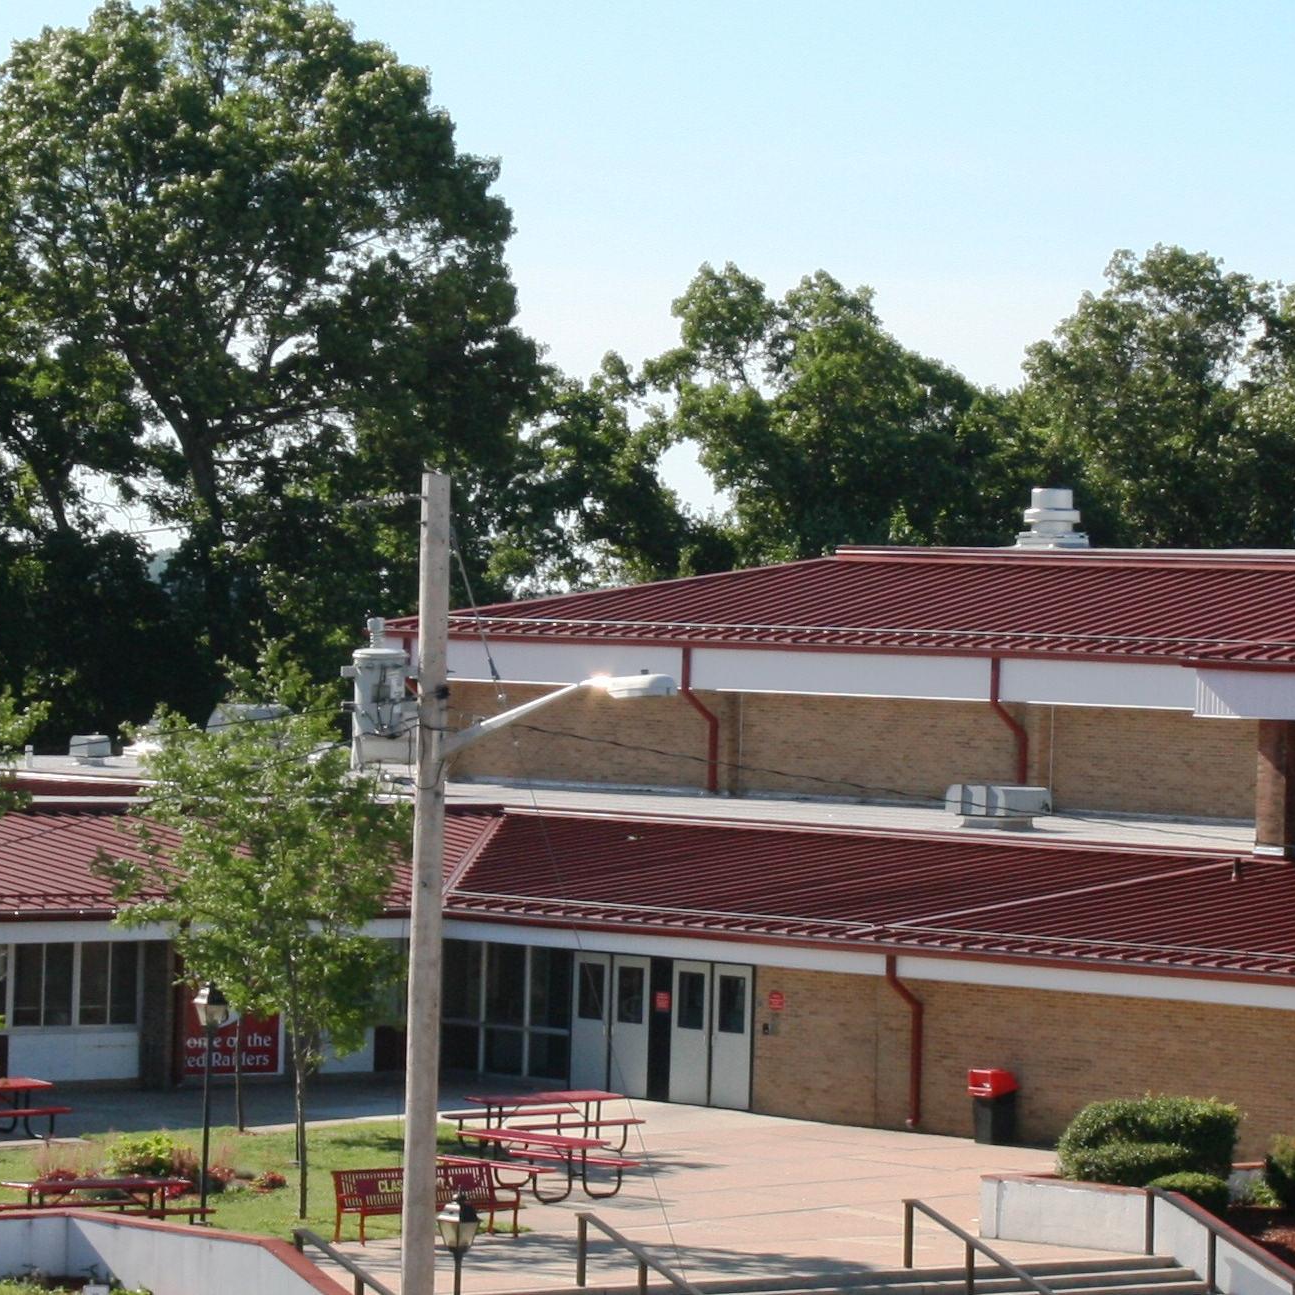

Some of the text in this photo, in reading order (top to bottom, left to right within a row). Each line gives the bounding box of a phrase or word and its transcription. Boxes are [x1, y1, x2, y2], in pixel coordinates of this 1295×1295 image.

[186, 1036, 222, 1049] ome
[247, 1033, 272, 1047] the
[185, 1053, 208, 1068] ed
[378, 1180, 403, 1193] CLAS
